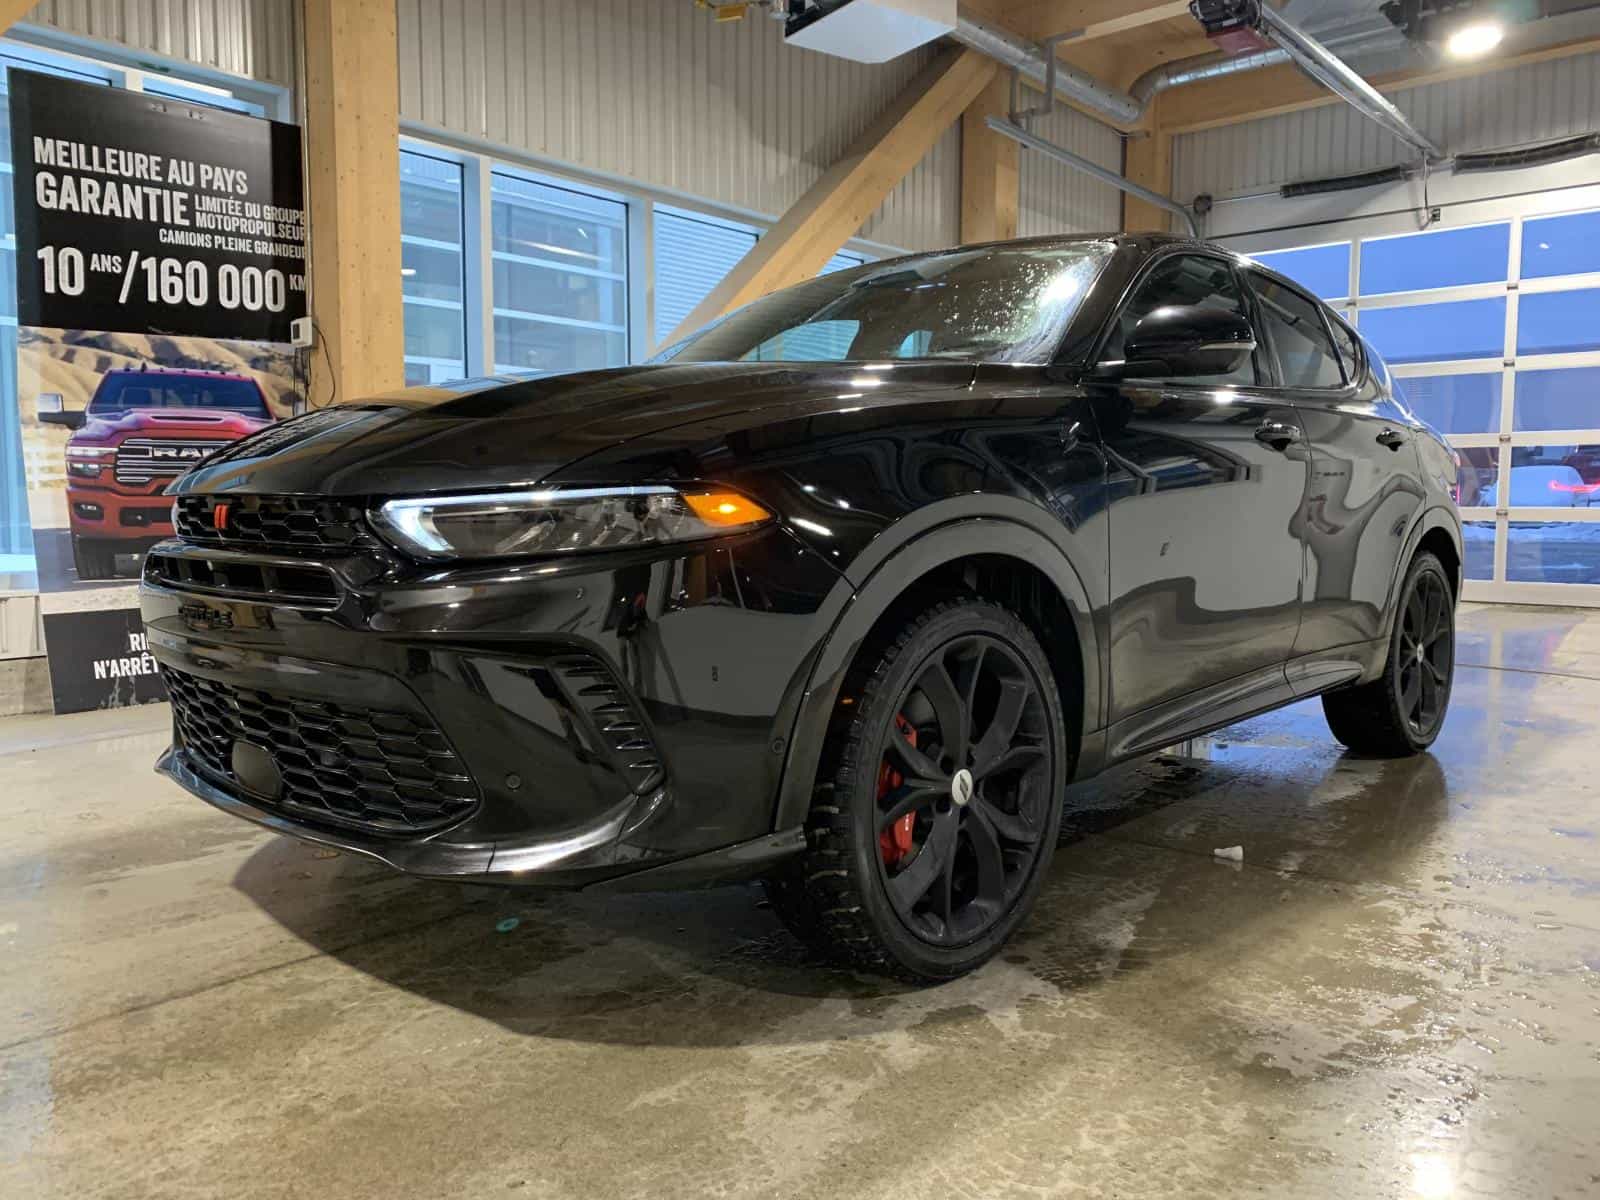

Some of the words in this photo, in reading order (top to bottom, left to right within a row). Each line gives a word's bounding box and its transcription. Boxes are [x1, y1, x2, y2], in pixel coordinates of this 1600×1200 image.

[34, 136, 163, 182] MEILLEURE
[168, 159, 194, 186] AU
[200, 163, 248, 195] PAYS
[35, 171, 190, 226] GARANTIE
[194, 194, 242, 216] LIMITÉE
[244, 202, 261, 218] DU
[159, 228, 212, 248] CAMIONS
[214, 235, 253, 253] PLEINE
[37, 246, 85, 296] 10
[90, 253, 122, 274] ANS
[218, 263, 285, 313] 000
[129, 632, 150, 652] RI
